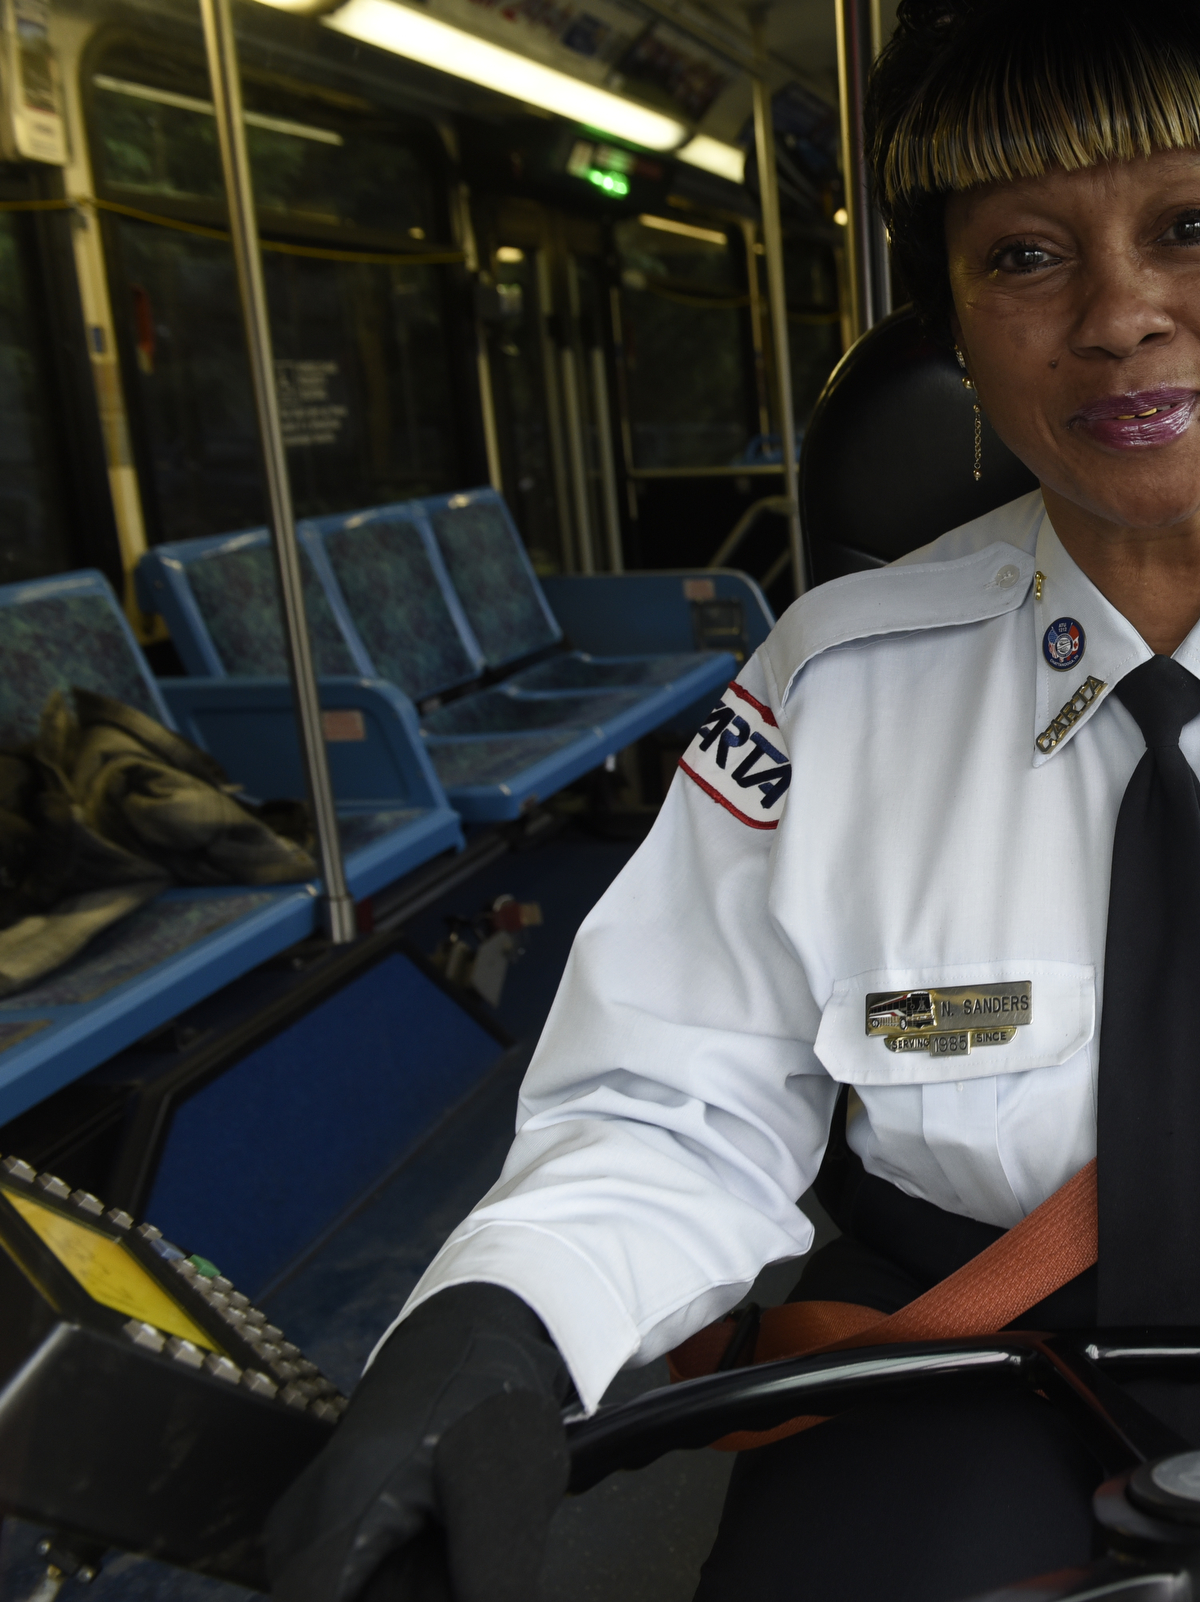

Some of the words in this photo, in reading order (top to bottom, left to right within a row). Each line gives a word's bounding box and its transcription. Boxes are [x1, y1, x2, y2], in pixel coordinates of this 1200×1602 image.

[1036, 675, 1105, 754] CARTA
[940, 1001, 954, 1017] N.
[963, 995, 1029, 1015] SANDERS
[890, 1037, 930, 1050] SERVING
[933, 1034, 967, 1052] 1985
[976, 1031, 1007, 1043] SINCE
